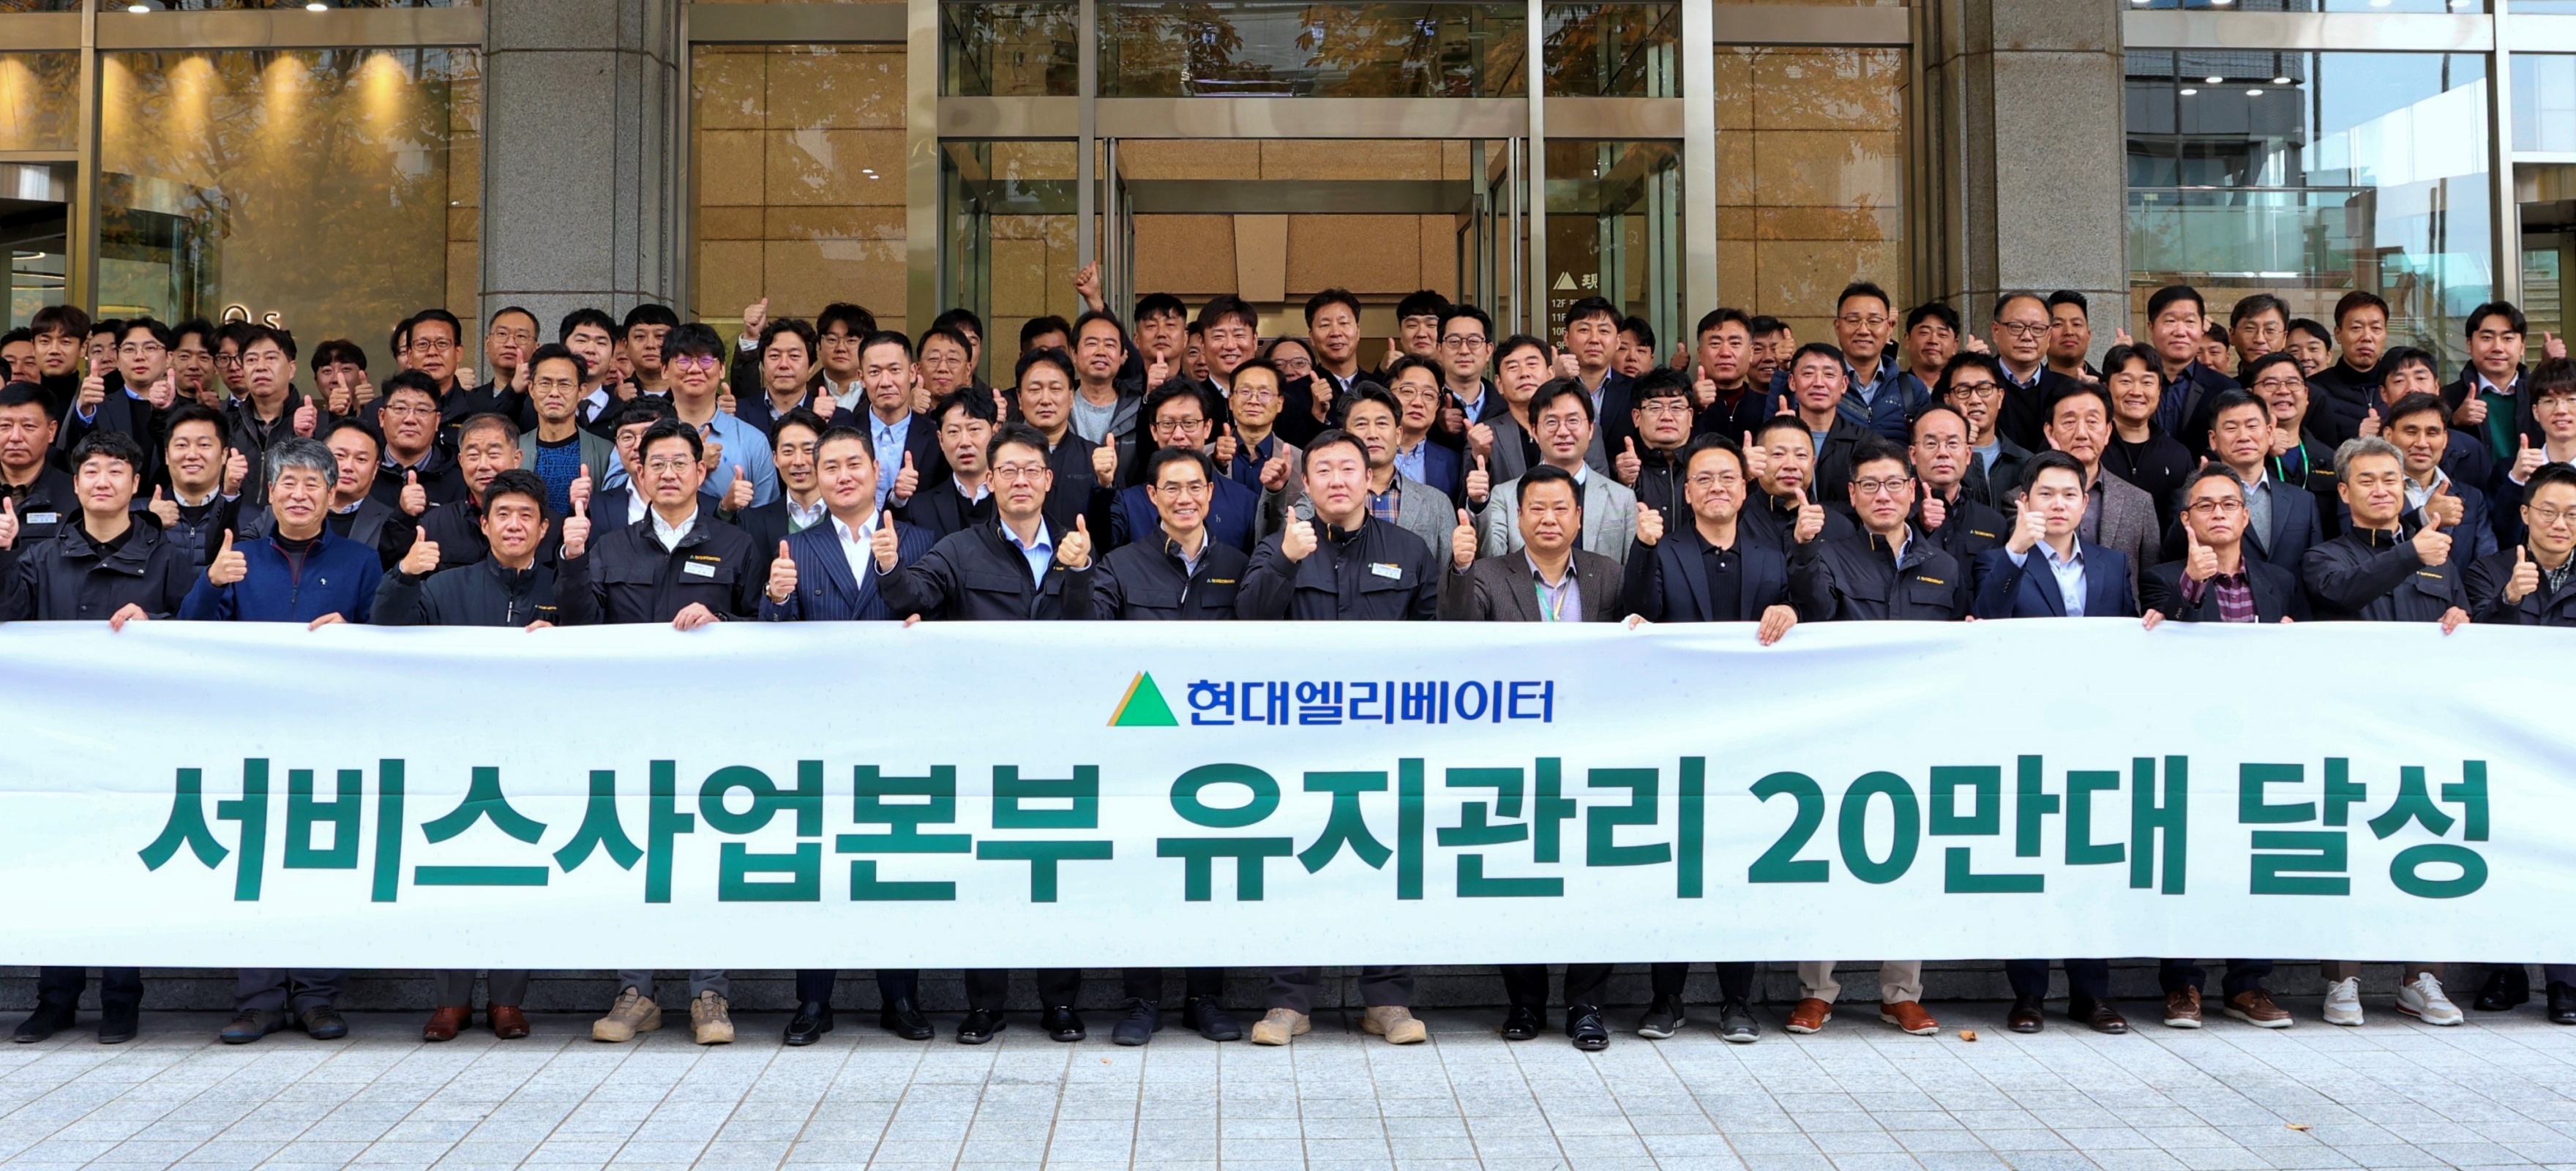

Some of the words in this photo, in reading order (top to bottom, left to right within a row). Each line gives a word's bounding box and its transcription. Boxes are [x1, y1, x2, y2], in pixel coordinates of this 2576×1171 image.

[1551, 299, 1566, 308] 12F
[1551, 313, 1567, 322] 11F
[1551, 326, 1566, 336] 10F
[1556, 341, 1566, 350] 9F
[1187, 679, 1554, 726] 현대엘리베이터
[138, 758, 1112, 904] 서비스사업본부
[1157, 757, 1706, 902] 유지관리
[1749, 755, 2188, 896] 20만대
[2239, 757, 2490, 899] 달성
